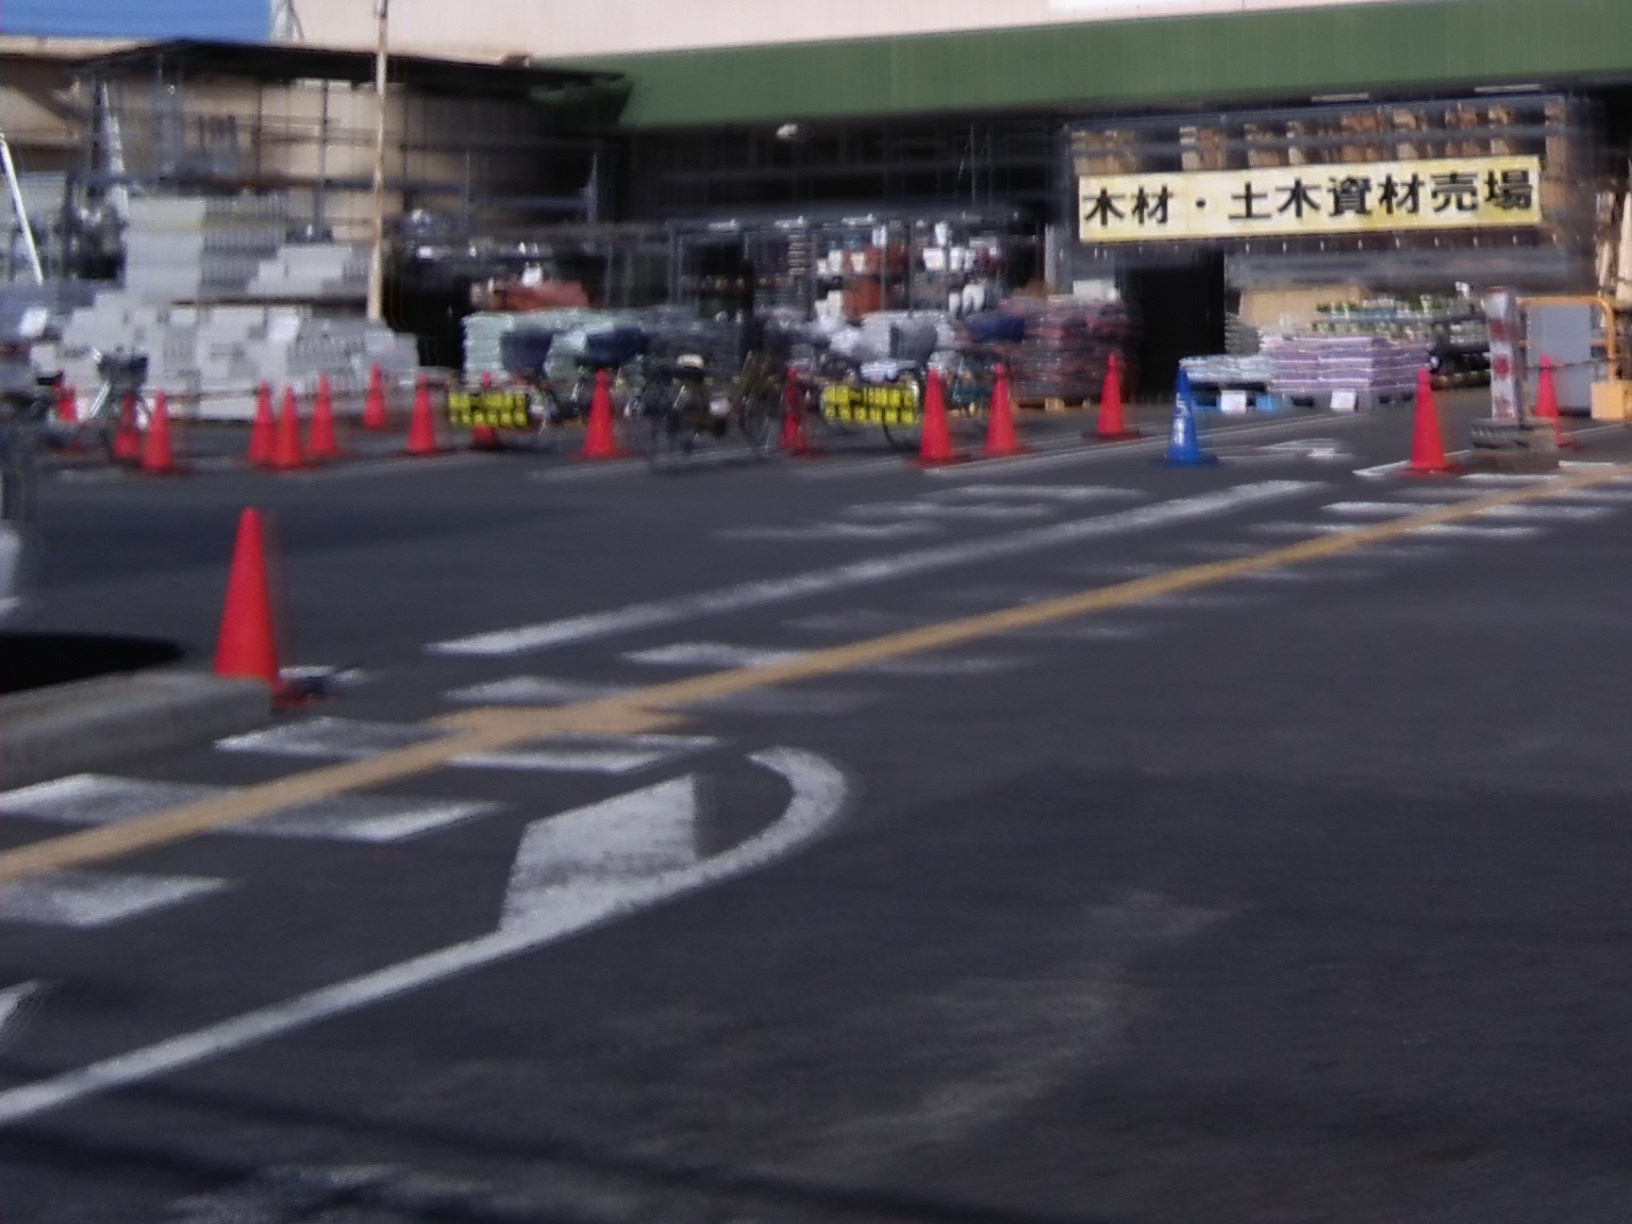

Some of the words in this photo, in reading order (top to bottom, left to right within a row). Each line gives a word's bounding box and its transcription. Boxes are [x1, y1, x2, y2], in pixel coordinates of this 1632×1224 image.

[1082, 168, 1534, 227] 木材・土木資材売場
